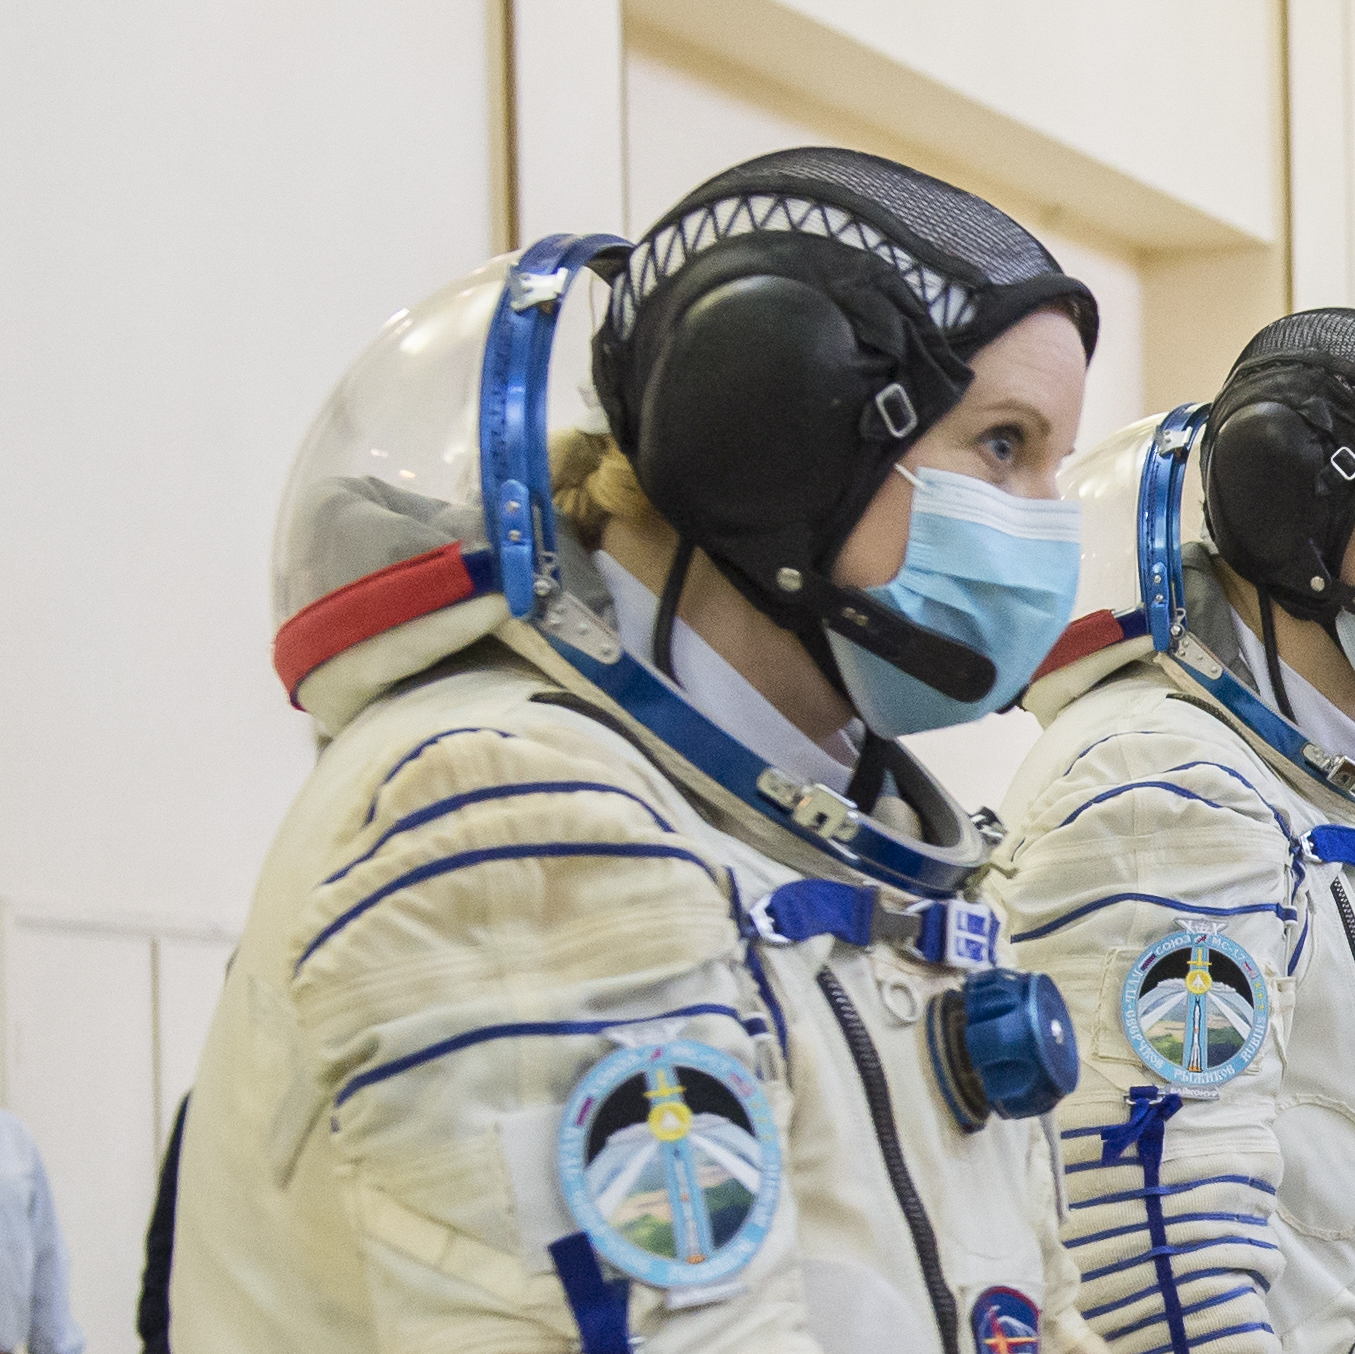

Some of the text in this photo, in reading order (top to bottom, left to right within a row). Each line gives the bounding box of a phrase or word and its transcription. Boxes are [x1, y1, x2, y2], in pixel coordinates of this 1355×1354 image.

[1155, 935, 1247, 962] СОЮЗ МС-17
[1240, 1015, 1267, 1061] RUBINS
[1172, 1065, 1235, 1084] РЫЖИКОВ
